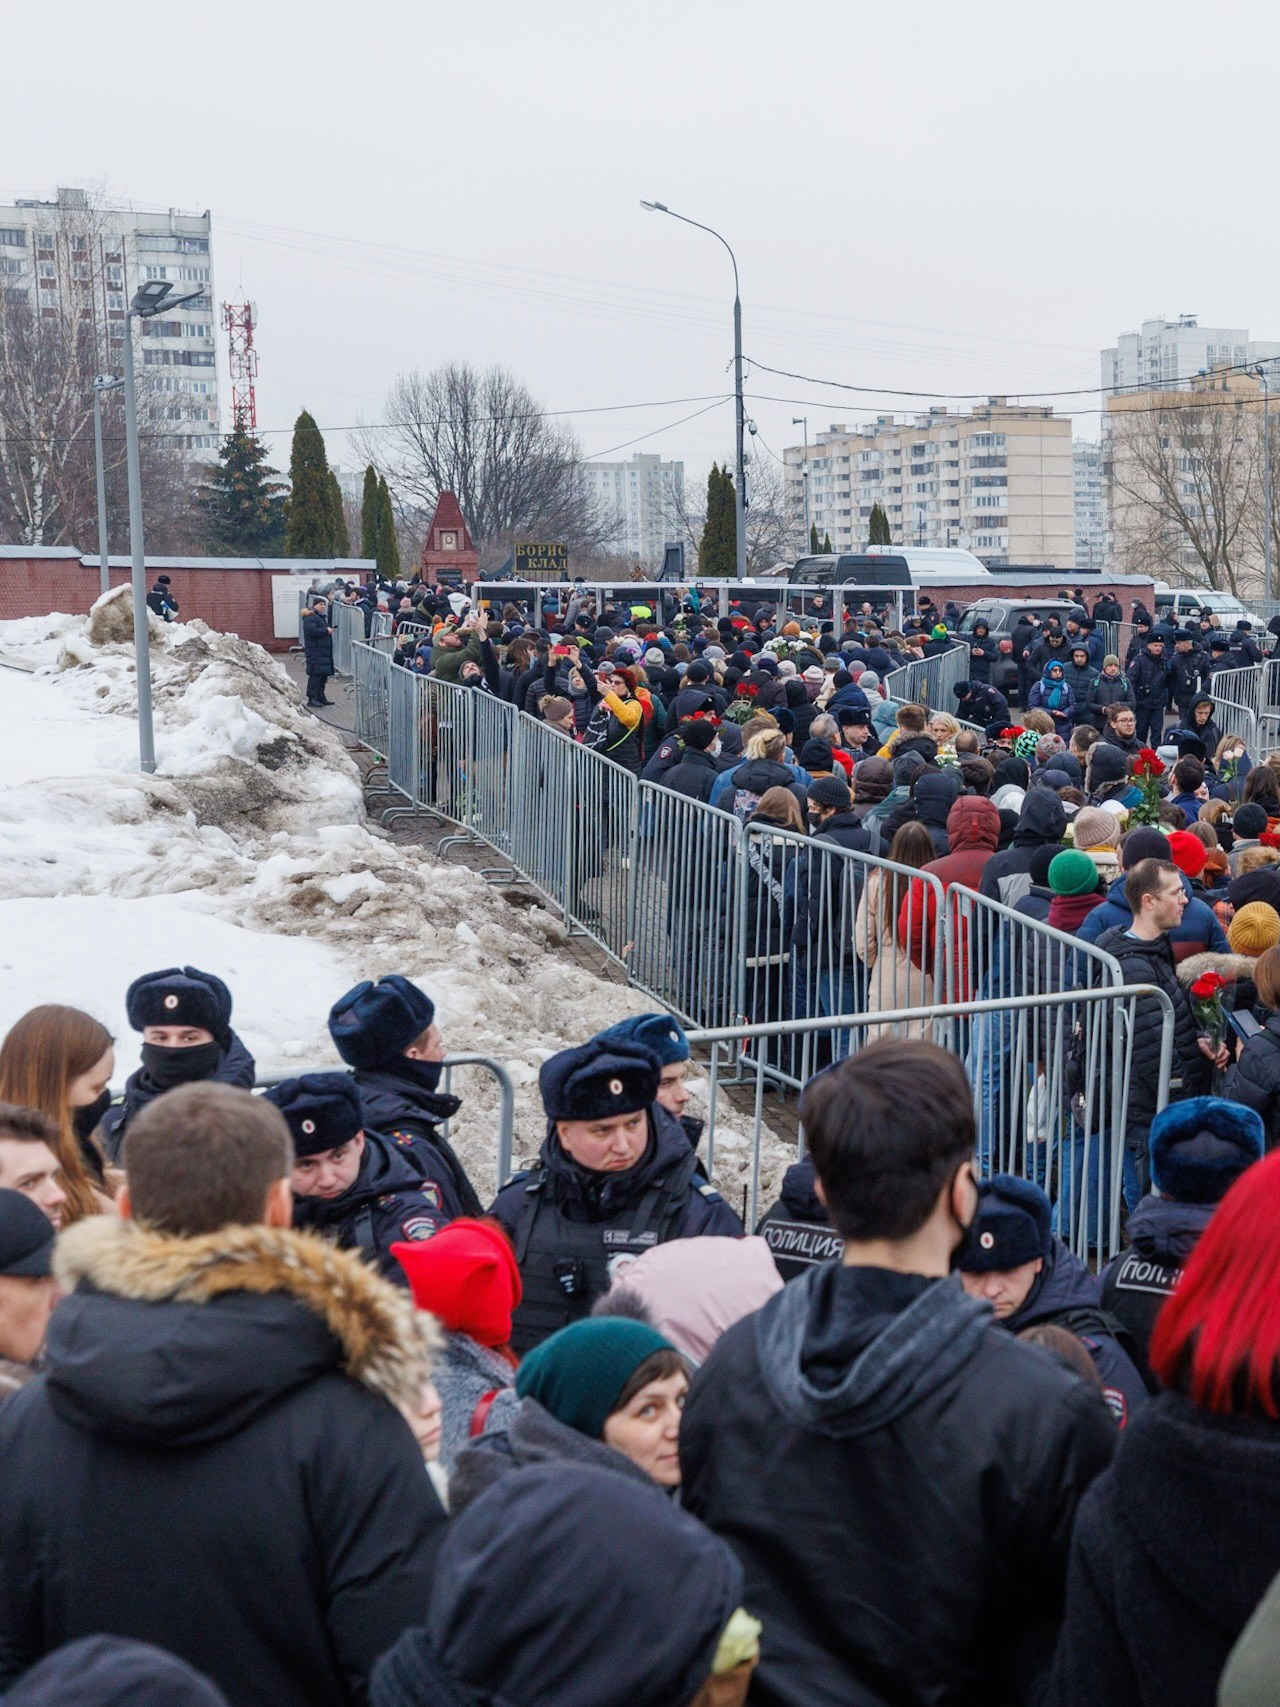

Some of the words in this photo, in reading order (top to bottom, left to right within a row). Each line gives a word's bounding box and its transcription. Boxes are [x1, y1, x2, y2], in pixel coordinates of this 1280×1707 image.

[517, 545, 567, 557] БОРИС
[528, 558, 568, 571] КЛАД
[764, 1227, 845, 1260] ПОЛИЦИЯ
